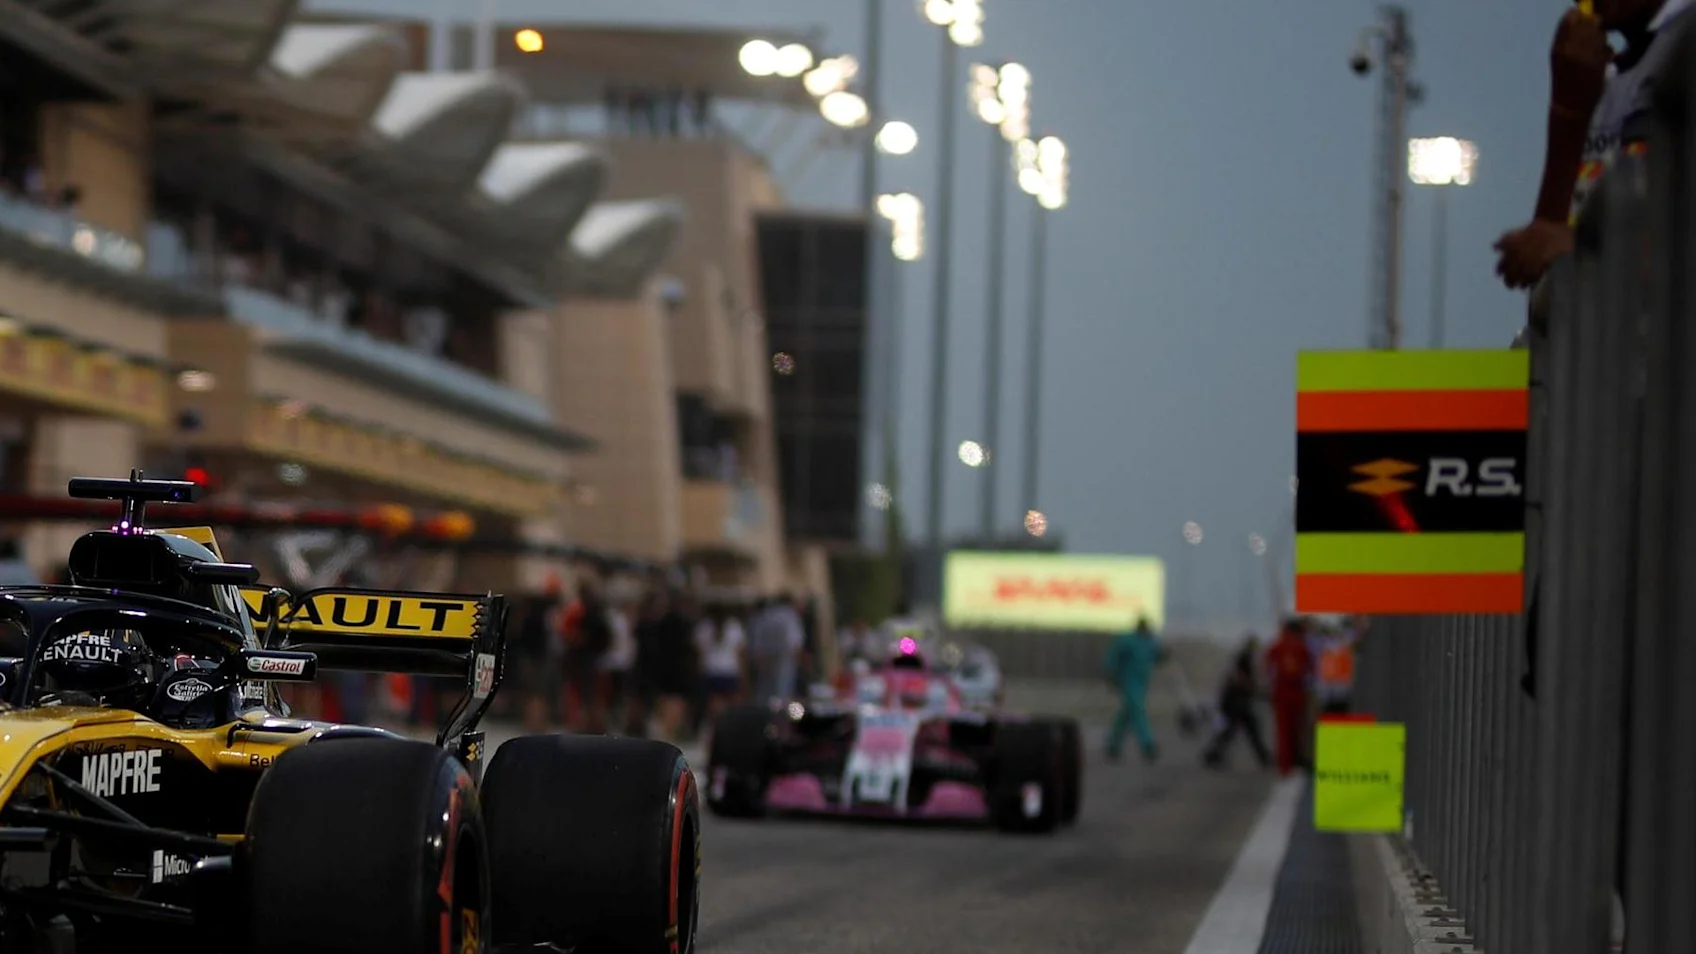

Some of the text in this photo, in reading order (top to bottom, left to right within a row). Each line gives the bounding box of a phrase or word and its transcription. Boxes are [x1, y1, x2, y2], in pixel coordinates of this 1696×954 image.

[1424, 457, 1522, 497] R.S.
[261, 658, 301, 673] Castrol
[174, 683, 209, 693] Estrella
[81, 749, 163, 798] MAPFRE
